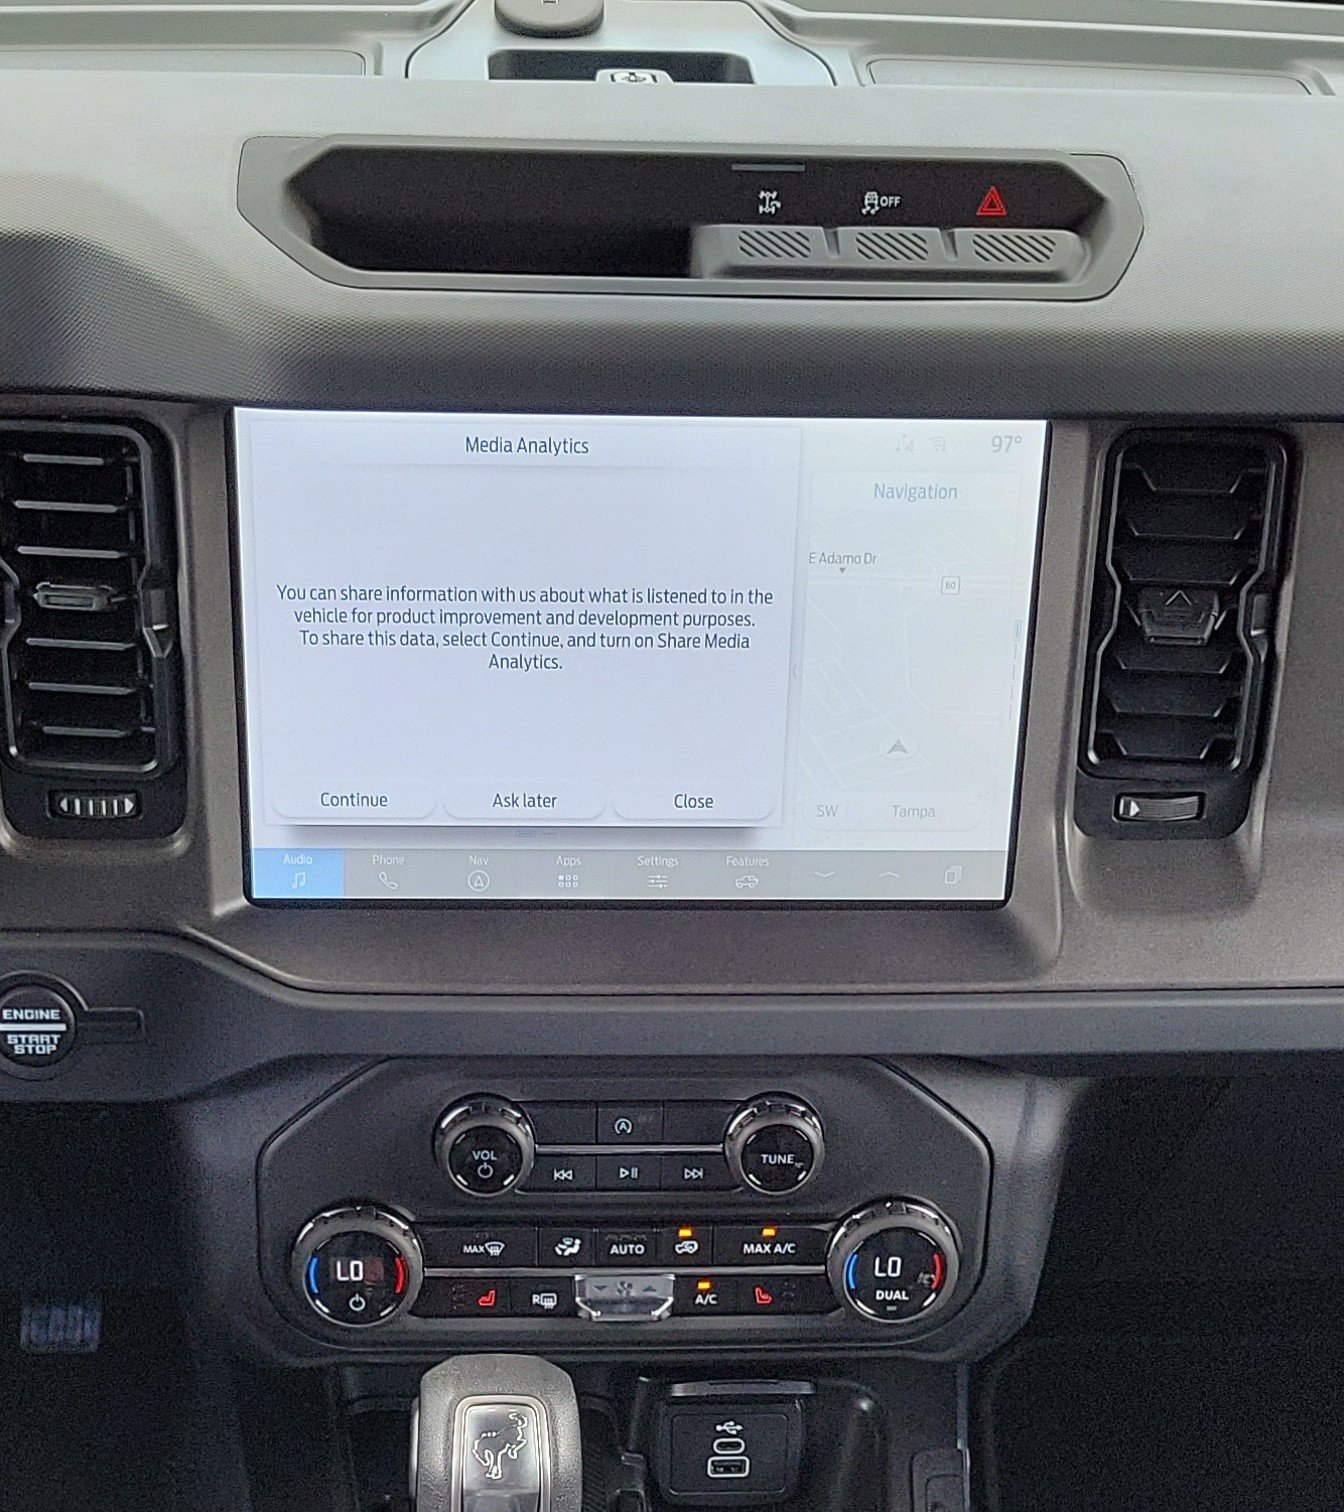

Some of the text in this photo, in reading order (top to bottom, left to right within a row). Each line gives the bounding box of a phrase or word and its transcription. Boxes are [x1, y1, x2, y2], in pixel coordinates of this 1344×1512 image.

[879, 195, 901, 207] OFF
[464, 434, 590, 458] Media Analytics
[991, 435, 1023, 453] 97°
[873, 482, 958, 503] Navigation
[809, 552, 877, 565] E Adamo Dr
[276, 584, 774, 605] You can share information with us about what is listened to in the
[294, 607, 756, 629] vehicle for product improvement and development purposes.
[299, 629, 751, 650] To share this data, select Continue, and turn on Share Media
[488, 653, 563, 672] Analytics.
[320, 791, 389, 809] Continue
[492, 792, 558, 809] Ask later
[673, 793, 714, 810] Close
[816, 804, 839, 818] SW
[892, 804, 936, 820] Tampa
[283, 853, 313, 866] Audio
[372, 854, 405, 867] Phone
[468, 854, 490, 867] Nav
[556, 855, 582, 870] Apps
[637, 855, 680, 870] Settings
[725, 856, 771, 868] Features
[2, 1008, 61, 1020] ENGINE
[6, 1034, 61, 1045] START
[14, 1044, 57, 1054] STOP
[472, 1149, 497, 1161] VOL
[761, 1153, 795, 1165] TUNE
[463, 1244, 485, 1254] MAX
[610, 1244, 645, 1255] AUTO
[743, 1242, 796, 1254] MAX A/C
[336, 1260, 364, 1281] LO
[874, 1256, 902, 1278] LO
[695, 1293, 717, 1305] A/C
[875, 1289, 909, 1301] DUAL
